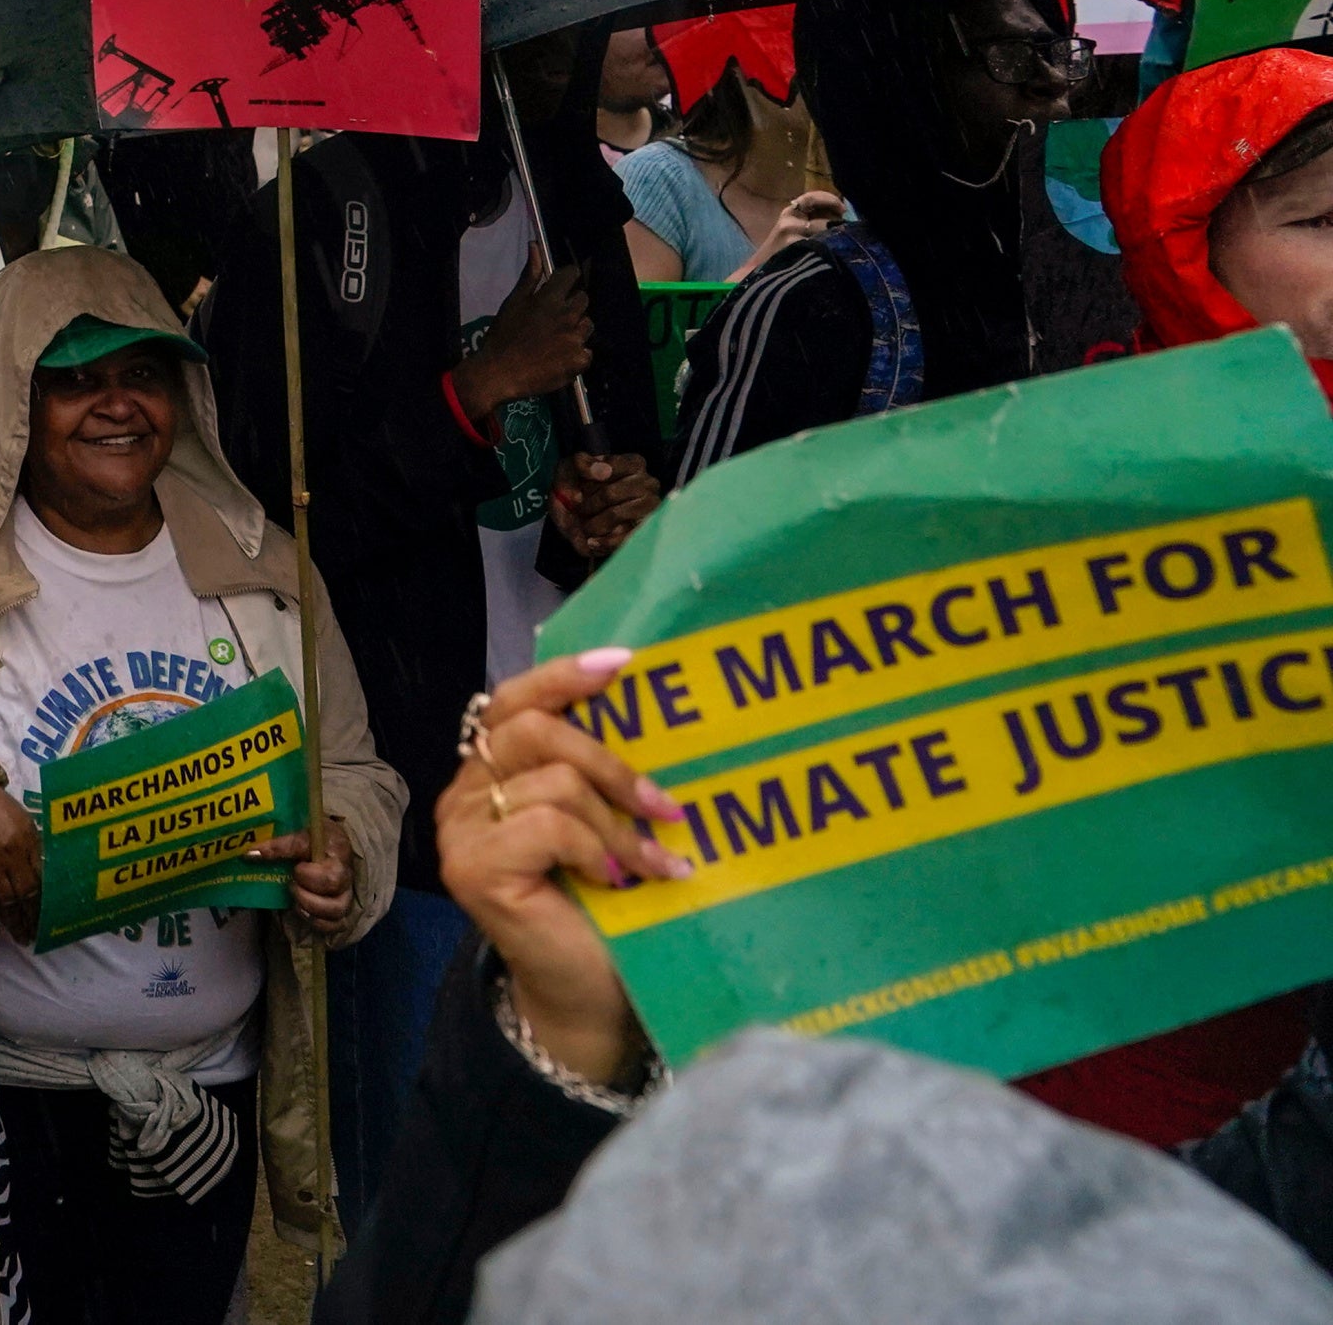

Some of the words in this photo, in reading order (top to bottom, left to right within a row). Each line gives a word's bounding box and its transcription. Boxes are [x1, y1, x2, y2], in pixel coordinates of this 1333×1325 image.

[341, 200, 368, 303] OGIO
[566, 662, 702, 741] WE
[714, 568, 1063, 710] MARCH
[1084, 527, 1297, 615] FOR
[21, 657, 123, 764] CLIMATE
[126, 650, 234, 703] DEFEN
[61, 745, 235, 823] MARCHAMOS
[241, 723, 287, 761] POR
[107, 826, 140, 850] LA
[147, 786, 261, 844] JUSTICIA
[615, 730, 968, 889] IMATE
[1002, 646, 1333, 796] JUSTIC
[113, 828, 257, 885] CLIMÁTICA
[157, 910, 192, 948] DE
